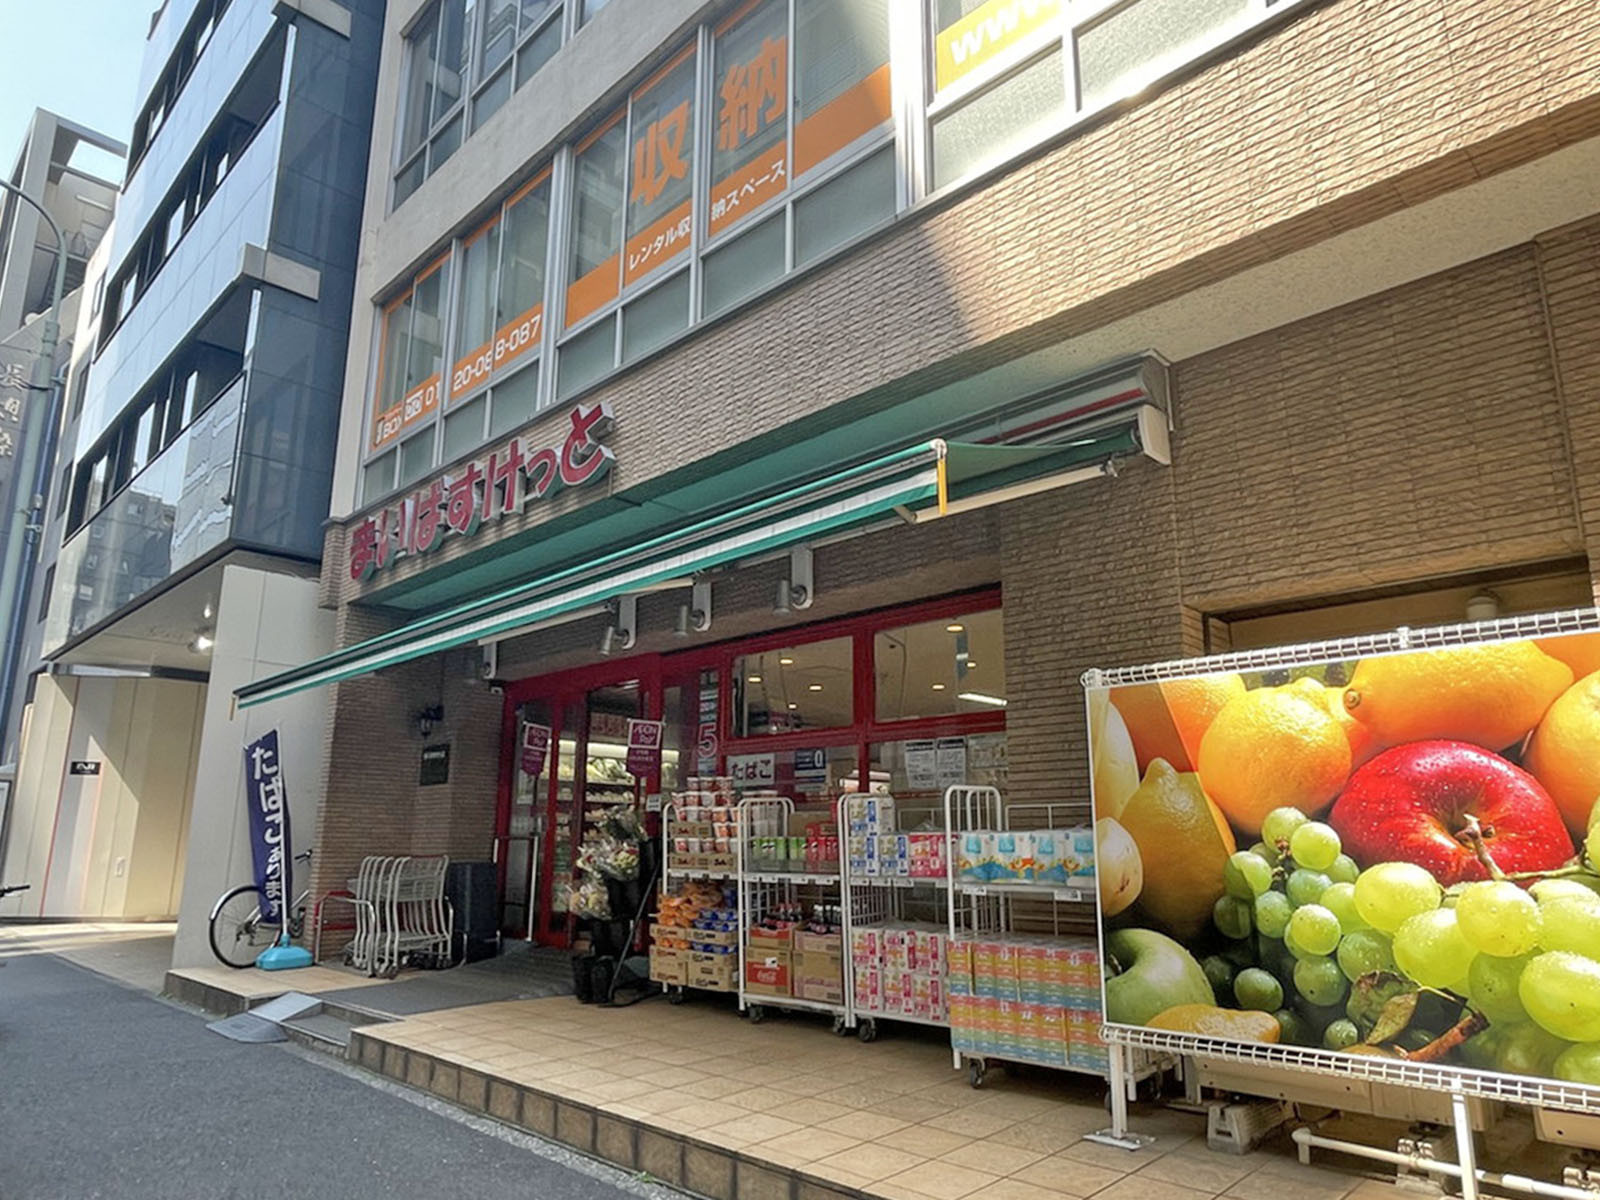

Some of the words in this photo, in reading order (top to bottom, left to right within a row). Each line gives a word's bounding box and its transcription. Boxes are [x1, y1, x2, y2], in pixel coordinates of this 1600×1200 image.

[630, 36, 787, 206] 収納
[351, 402, 614, 580] まいばすけっと
[731, 759, 772, 780] たばこ
